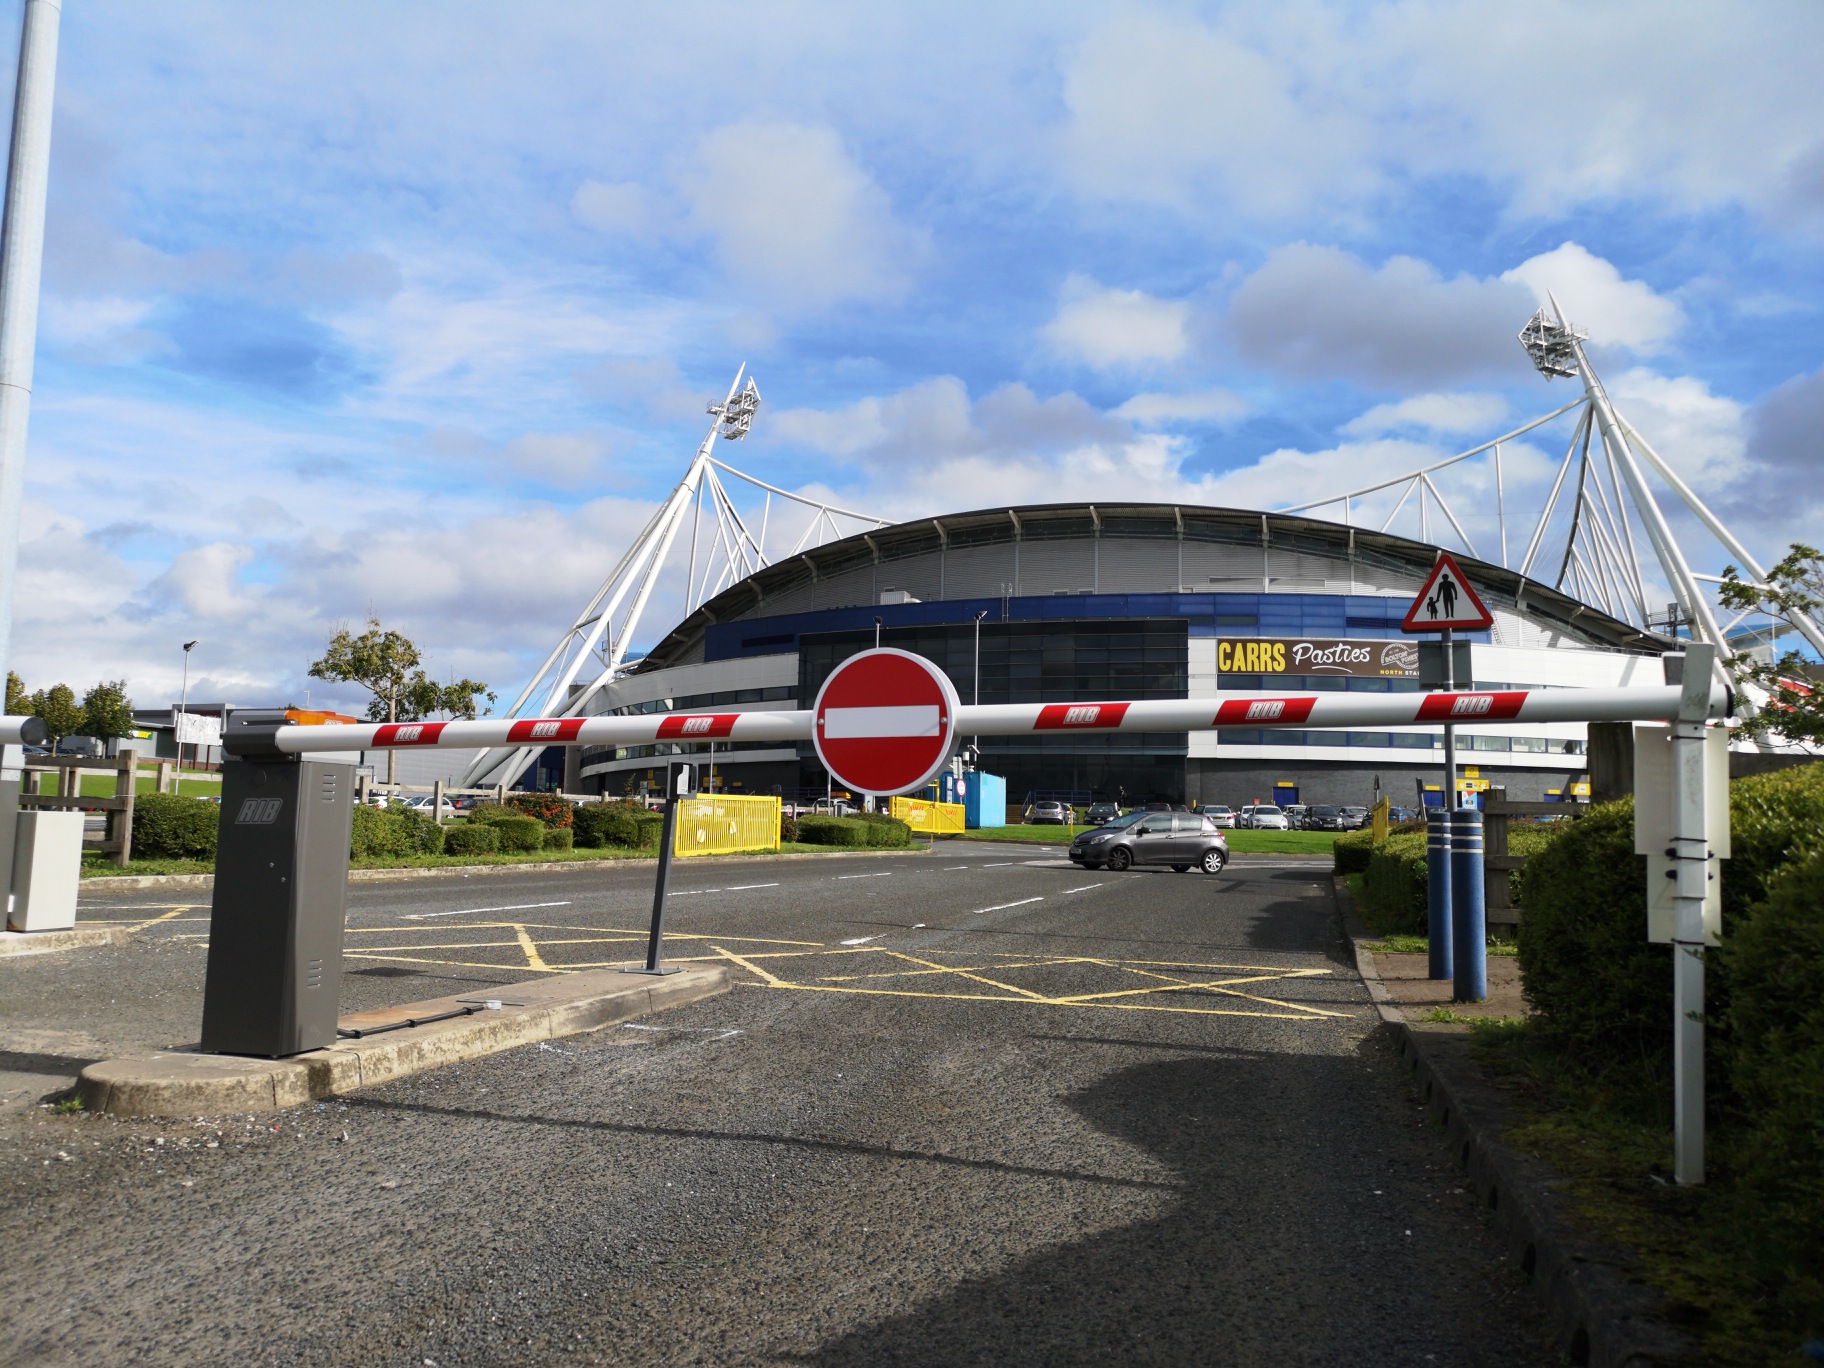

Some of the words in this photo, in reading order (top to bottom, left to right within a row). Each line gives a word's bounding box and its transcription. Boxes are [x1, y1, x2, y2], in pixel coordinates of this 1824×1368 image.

[1218, 642, 1286, 672] CARRS
[1292, 642, 1371, 666] Pasties
[1245, 701, 1285, 719] RIB
[1450, 696, 1494, 715] RIB
[1063, 707, 1100, 724] RIB
[394, 726, 423, 741] RIB
[530, 721, 562, 737] RIB
[681, 717, 714, 733] RIB
[235, 798, 284, 824] RIB
